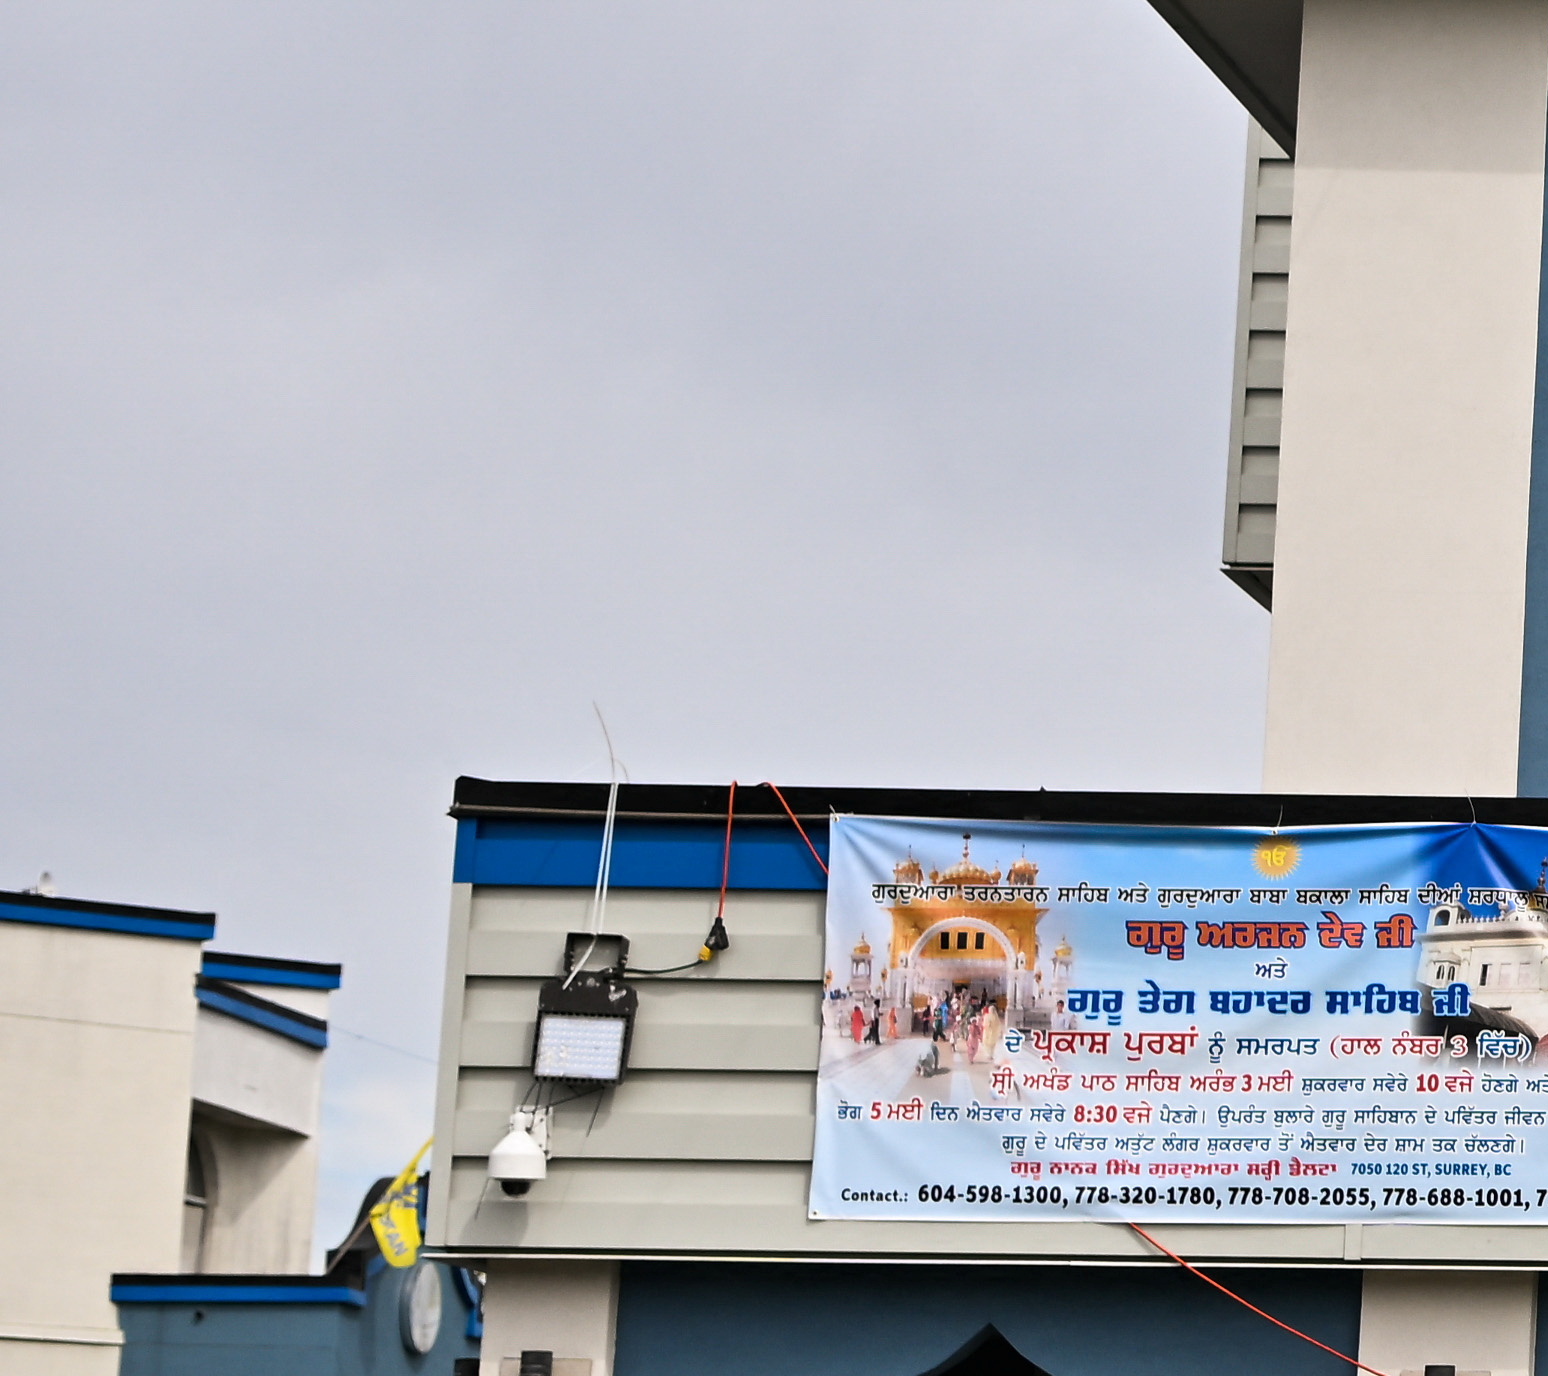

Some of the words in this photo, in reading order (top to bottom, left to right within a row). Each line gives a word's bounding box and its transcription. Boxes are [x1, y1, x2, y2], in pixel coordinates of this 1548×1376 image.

[871, 883, 956, 905] ਗੁਰਦੁਆਰਾ
[963, 885, 1050, 903] ਤਰਨਤਾਰਨ
[1057, 881, 1110, 904] ਸਾਹਿਬ
[1117, 881, 1150, 904] ਅਤੇ
[1157, 888, 1242, 909] ਗੁਰਦੁਆਰਾ
[1249, 889, 1288, 905] ਬਾਬਾ
[1296, 889, 1351, 905] ਬਕਾਲਾ
[1358, 883, 1411, 905] ਸਾਹਿਬ
[1417, 882, 1463, 905] ਦੀਆਂ
[1125, 919, 1188, 961] ਗੁਰੂ
[1195, 920, 1310, 950] ਅਰਜਨ
[1316, 910, 1368, 950] ਦੇਵ
[1374, 912, 1417, 950] ਜੀ
[1254, 956, 1288, 980] ਅਤੇ
[1067, 988, 1124, 1026] ਗੁਰੂ
[1137, 979, 1196, 1015] ਤੇਗ
[1208, 989, 1313, 1015] ਬਹਾਦਰ
[1324, 983, 1424, 1016] ਸਾਹਿਬ
[1432, 983, 1472, 1017] ਜੀ
[1004, 1029, 1024, 1054] ਦੇ
[1123, 1025, 1199, 1062] ਪੁਰਬਾਂ
[1235, 1037, 1320, 1057] ਸਮਰਪਤ
[1329, 1034, 1383, 1060] (ਹਾਲ
[1391, 1030, 1443, 1058] ਨੰਬਰ
[1450, 1037, 1469, 1057] 3
[1023, 1067, 1072, 1092] ਅਖੰਡ
[1081, 1074, 1117, 1092] ਪਾਠ
[1125, 1068, 1182, 1092] ਸਾਹਿਬ
[1189, 1068, 1237, 1093] ਅਰੰਭ
[1241, 1073, 1252, 1093] 3
[1257, 1069, 1294, 1093] ਮਈ
[1372, 1072, 1409, 1094] ਸਵੇਰੇ
[1416, 1074, 1439, 1093] 10
[1444, 1069, 1475, 1094] ਵਜੇ
[870, 1101, 882, 1120] 5
[887, 1097, 924, 1122] ਮਈ
[930, 1101, 960, 1122] ਦਿਨ
[1029, 1102, 1067, 1123] ਸਵੇਰੇ
[1073, 1104, 1118, 1124] 8:30
[1122, 1100, 1153, 1125] ਵਜੇ
[1322, 1109, 1347, 1131] ਗੁਰੂ
[1353, 1104, 1418, 1125] ਸਾਹਿਬਾਨ
[1424, 1104, 1438, 1125] ਦੇ
[1504, 1105, 1547, 1126] ਜੀਵਨ
[1002, 1135, 1028, 1156] ਗੁਰੂ
[1034, 1131, 1048, 1152] ਦੇ
[1162, 1131, 1200, 1153] ਲੰਗਰ
[1300, 1131, 1357, 1154] ਐਤਵਾਰ
[1364, 1132, 1388, 1153] ਦੇਰ
[1431, 1138, 1457, 1153] ਤਕ
[1010, 1161, 1042, 1181] ਗੁਰੂ
[1049, 1161, 1098, 1175] ਨਾਨਕ
[1148, 1162, 1240, 1179] ਗੁਰਦੁਆਰਾ
[1350, 1162, 1383, 1176] 7050
[1385, 1162, 1408, 1176] 120
[1411, 1162, 1431, 1178] ST,
[1434, 1162, 1491, 1178] SURREY,
[1493, 1163, 1512, 1176] BC
[917, 1183, 1069, 1208] 604-598-1300,
[1074, 1185, 1222, 1209] 778-320-1780,
[1227, 1186, 1377, 1210] 778-708-2055,
[1382, 1187, 1531, 1211] 778-688-1001,
